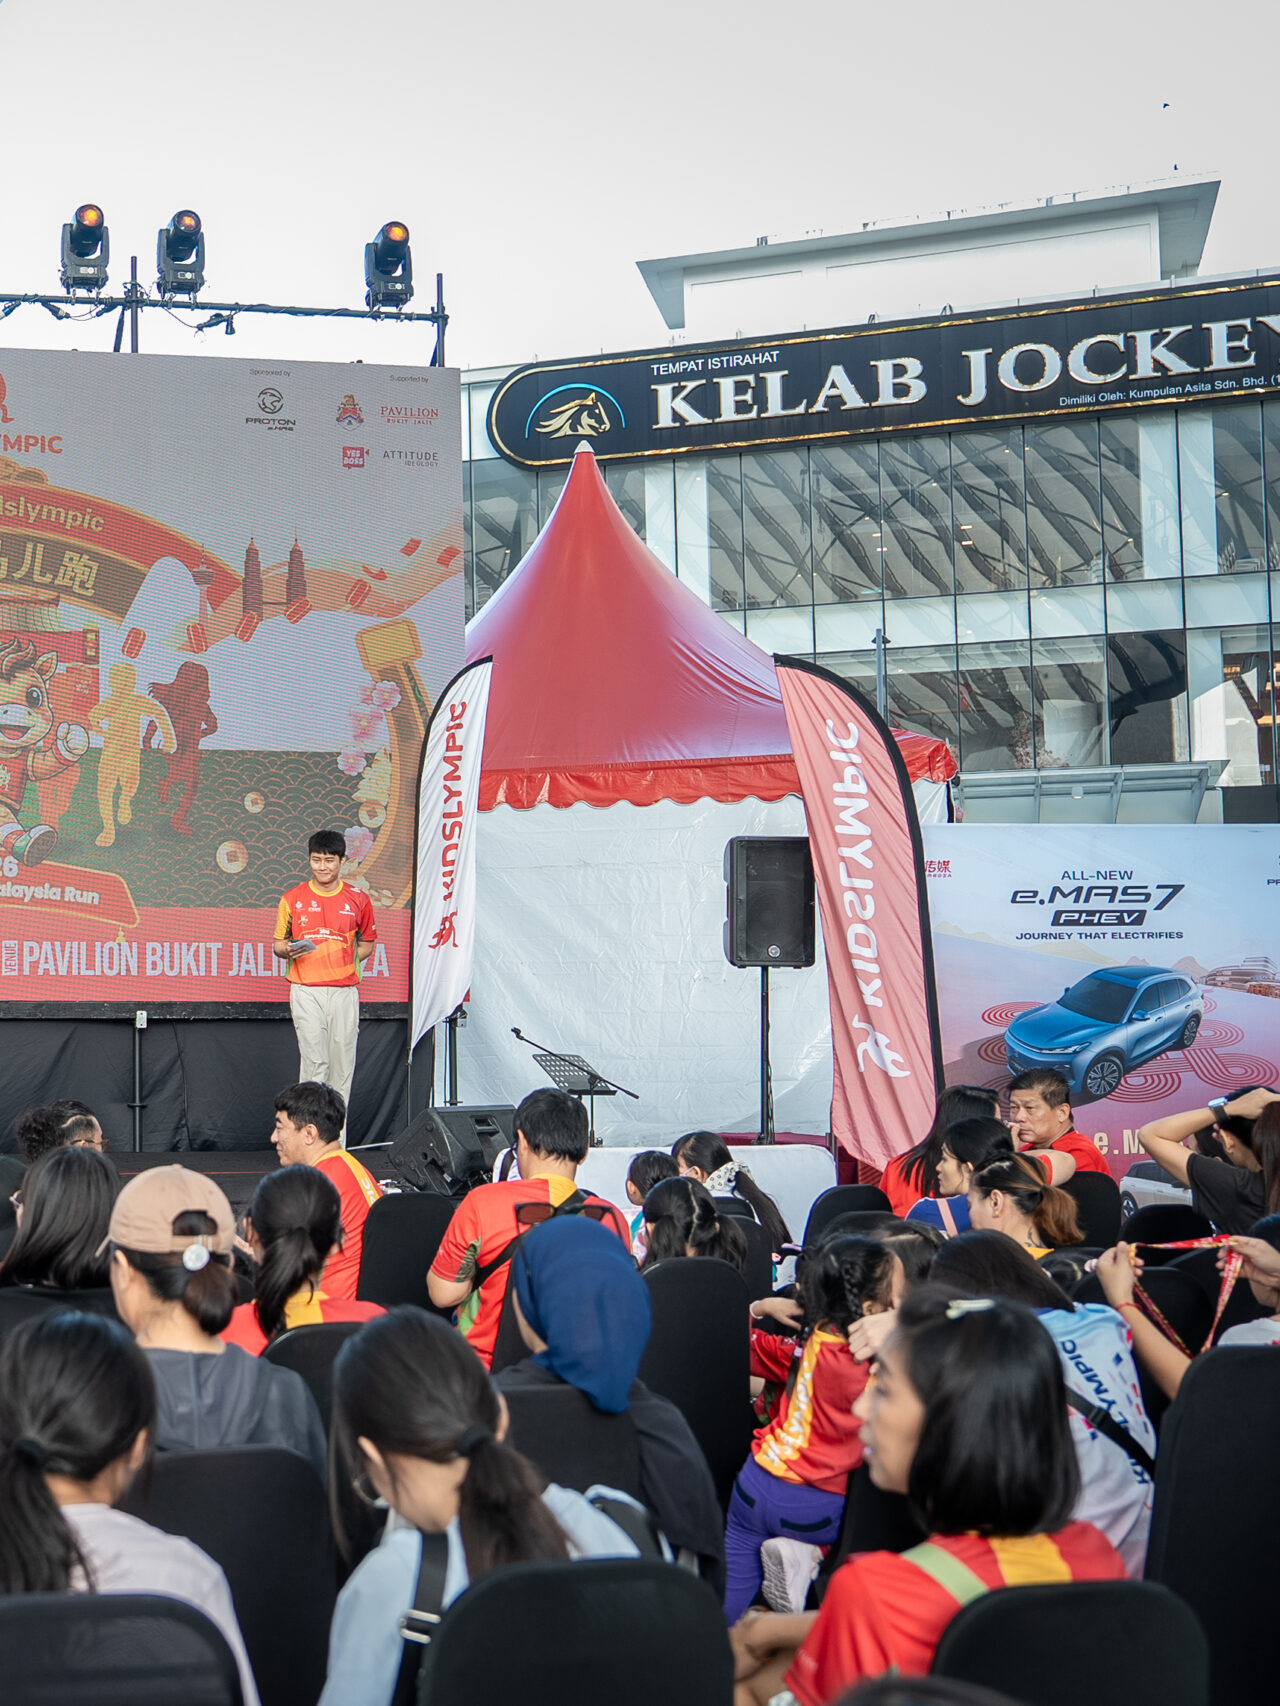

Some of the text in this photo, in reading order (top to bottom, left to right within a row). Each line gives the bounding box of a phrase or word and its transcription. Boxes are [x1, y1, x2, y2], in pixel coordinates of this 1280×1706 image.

[651, 350, 780, 376] TEMPAT ISTIRAHAT
[650, 356, 928, 430] KELAB
[1059, 393, 1096, 406] Dimiliki
[1098, 391, 1127, 402] Oleh:
[1129, 386, 1183, 399] Kumpulan
[1184, 381, 1211, 393] Asita
[1214, 379, 1240, 390] Sdn.
[1243, 376, 1268, 387] Bhd.
[380, 405, 440, 418] PAVILION
[245, 417, 296, 426] PROTON
[346, 449, 361, 458] YES
[382, 450, 439, 461] ATTITUDE
[343, 457, 365, 465] BOSS
[1061, 870, 1134, 881] ALL-NEW
[64, 886, 100, 905] Run
[1059, 912, 1141, 924] PHEV
[1015, 931, 1184, 941] JOURNEY THAT ELECTRIFIES
[3, 941, 17, 974] VENUE
[23, 940, 139, 976] PAVILION
[146, 942, 223, 976] BUKIT
